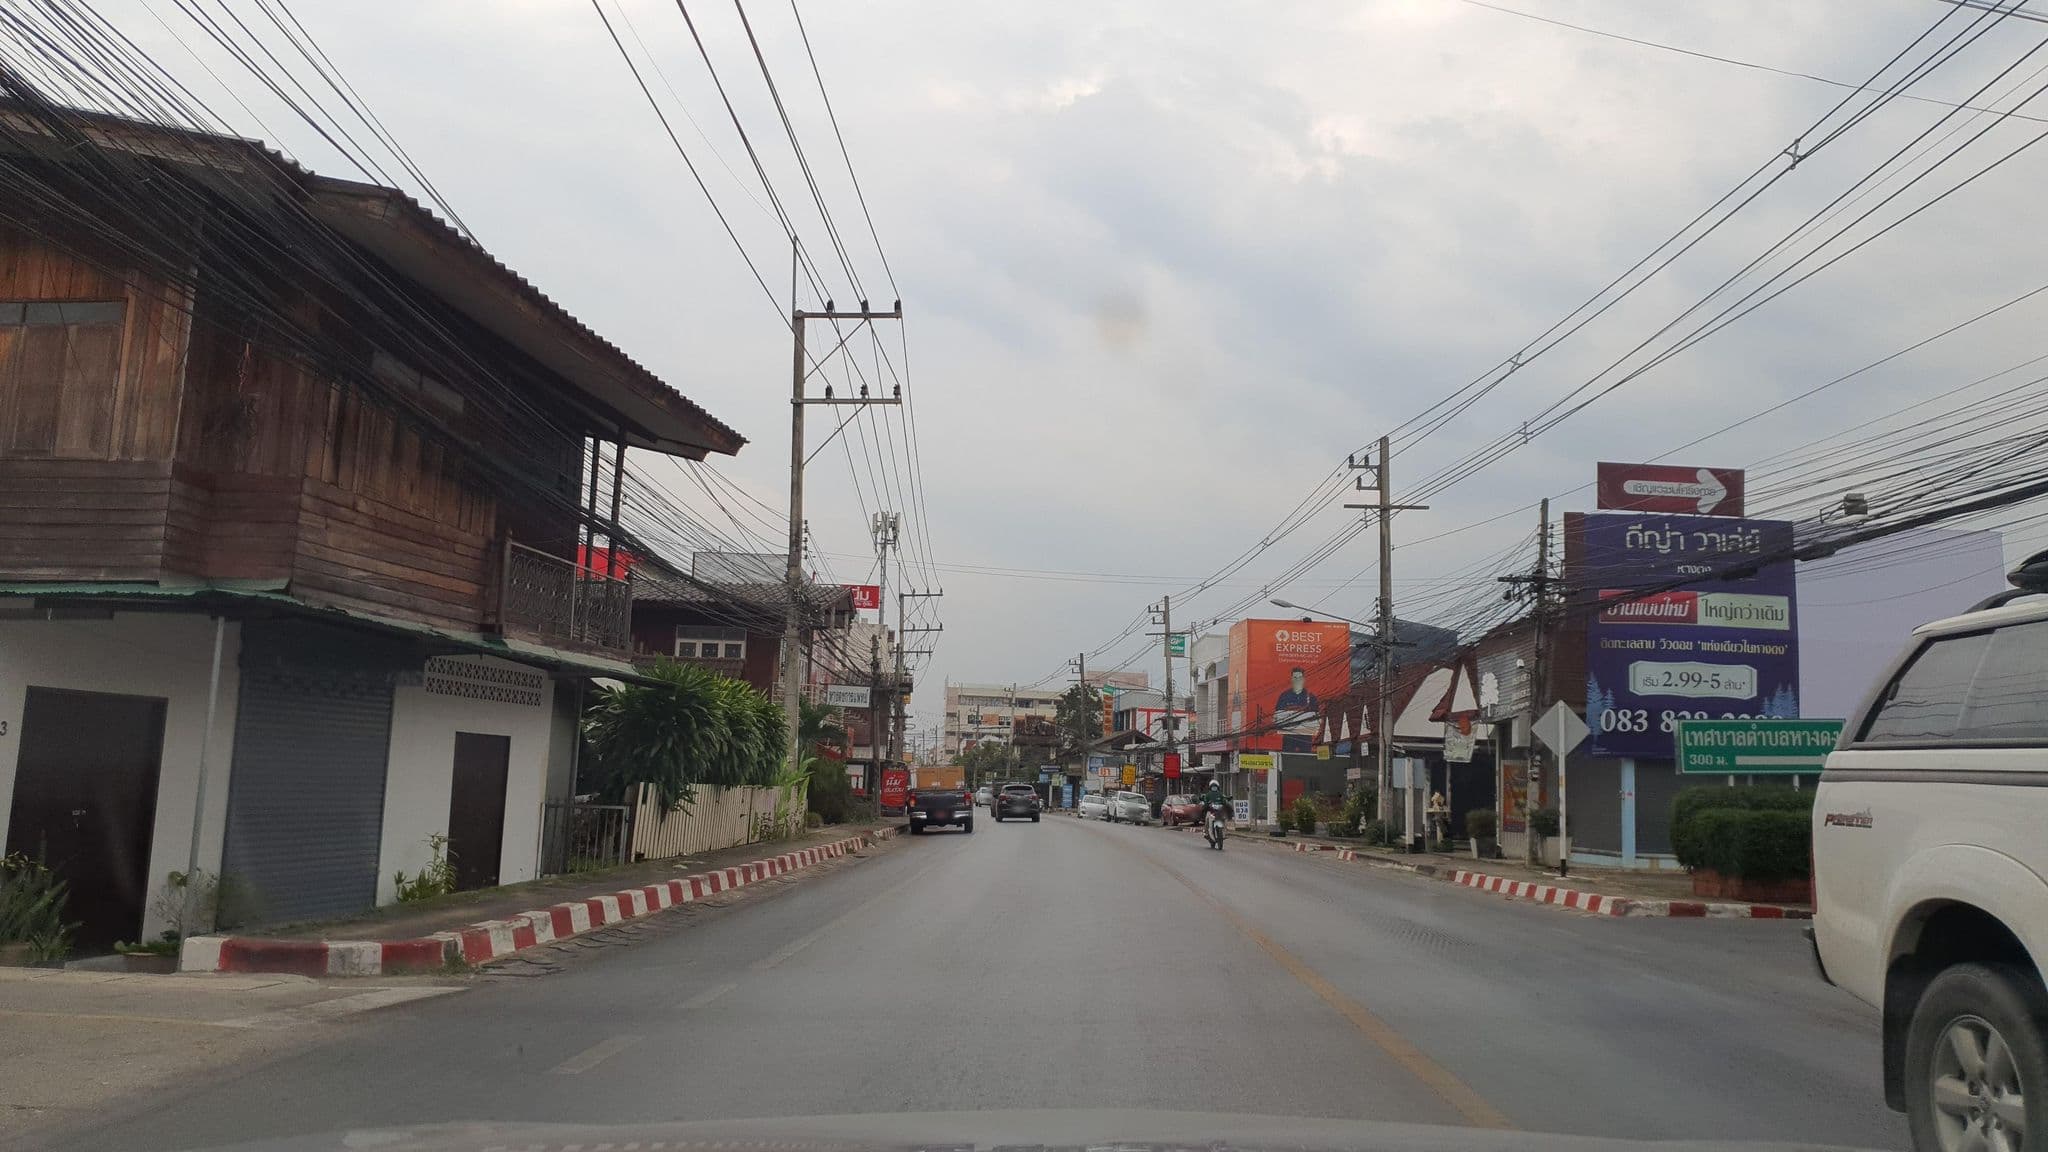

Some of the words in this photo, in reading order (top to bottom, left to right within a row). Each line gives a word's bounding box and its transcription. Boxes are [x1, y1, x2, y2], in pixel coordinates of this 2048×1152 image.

[1607, 596, 1690, 617] บานแบบใหม่
[1701, 599, 1785, 622] ใหญ่กว่าเดิม
[1291, 632, 1323, 642] BEST
[1276, 643, 1322, 653] EXPRESS
[1662, 671, 1721, 690] 2.99-5
[1600, 709, 1649, 732] 083
[1689, 753, 1714, 766] 300
